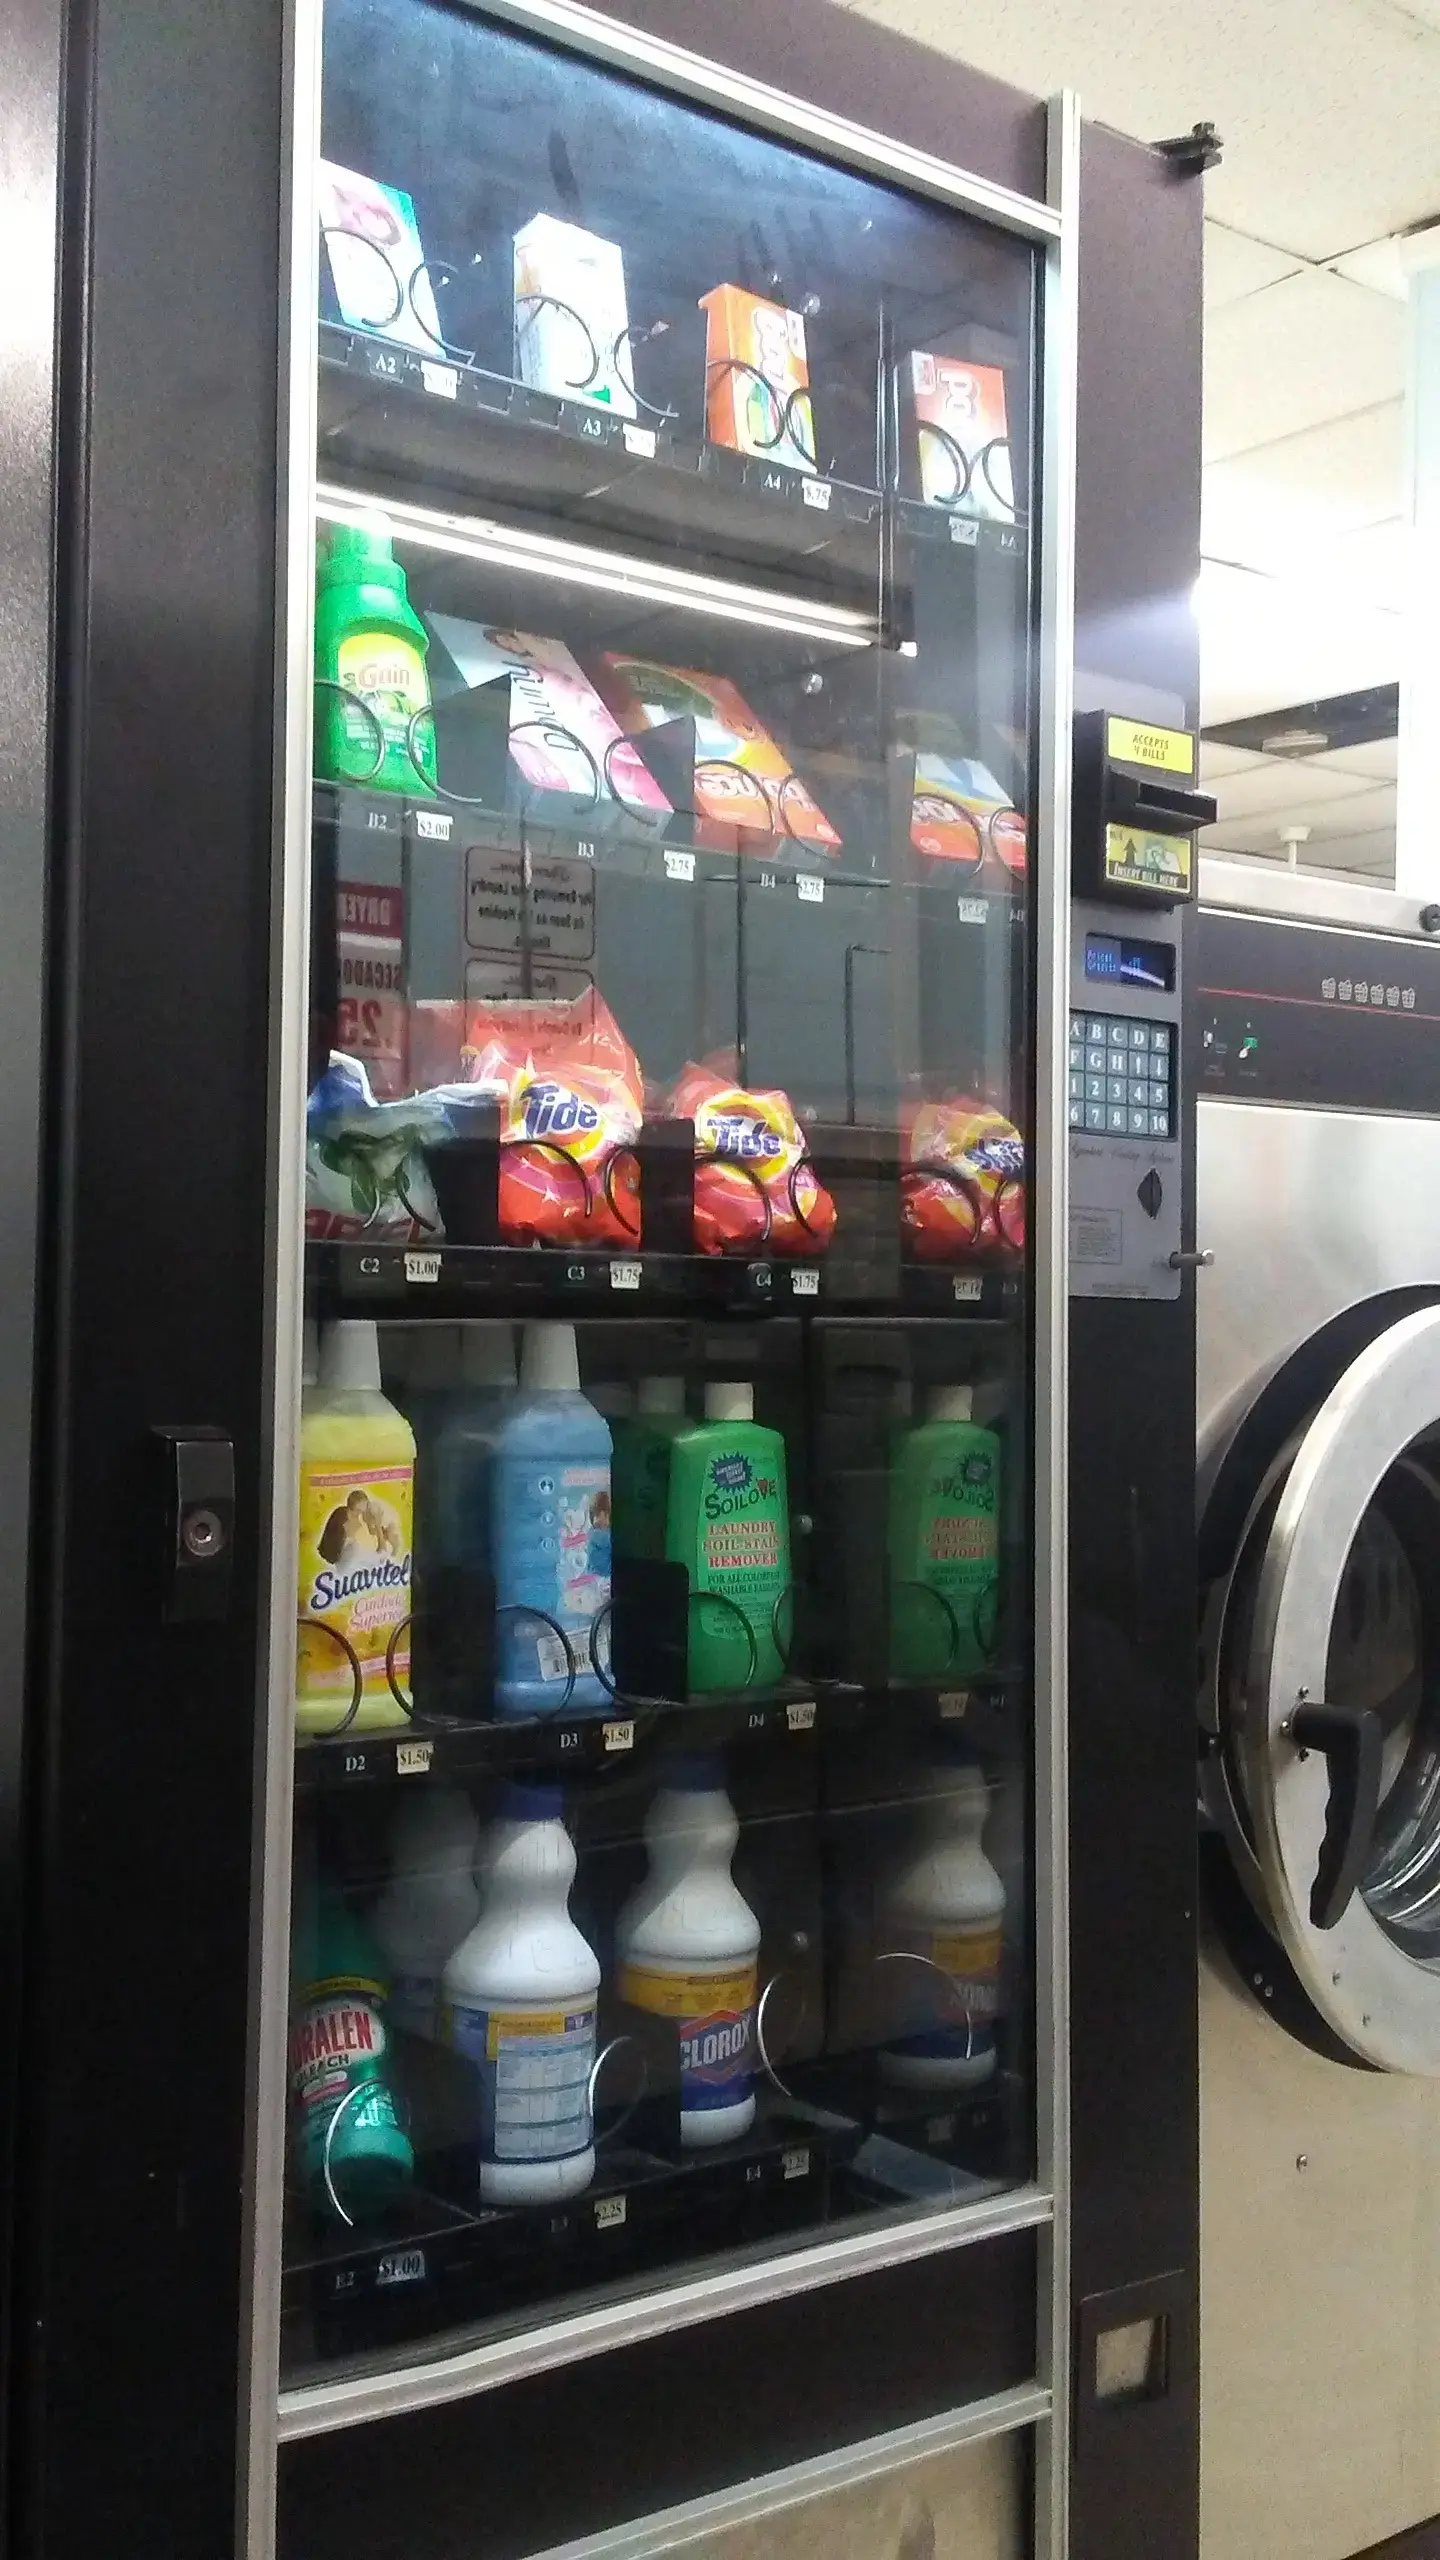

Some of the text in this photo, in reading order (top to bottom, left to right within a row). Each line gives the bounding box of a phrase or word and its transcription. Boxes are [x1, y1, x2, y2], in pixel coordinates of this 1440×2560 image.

[375, 354, 396, 373] A2
[583, 418, 602, 436] A3
[764, 473, 781, 490] A4
[359, 664, 409, 688] Gain
[1132, 734, 1169, 750] ACCEPTS
[1142, 747, 1165, 761] BILLS
[419, 819, 448, 838] $2.00
[577, 841, 595, 858] B3
[664, 856, 693, 874] $2.75
[1070, 1021, 1165, 1048] A B C D E
[1070, 1049, 1123, 1070] F G H
[1071, 1078, 1163, 1103] 1 2 3 4 5
[521, 1083, 600, 1133] Tide
[1070, 1106, 1167, 1131] 6 7 8 9 10
[706, 1117, 781, 1156] Tide
[359, 1257, 380, 1274] C2
[408, 1259, 437, 1277] $1.00
[567, 1266, 586, 1281] C3
[613, 1267, 639, 1283] $1.75
[756, 1272, 772, 1287] C4
[709, 1521, 776, 1536] LAUNDRY
[708, 1551, 778, 1568] REMOVER
[310, 1553, 411, 1610] Suavitel
[708, 1573, 726, 1585] FOR
[560, 1732, 579, 1749] D3
[604, 1727, 630, 1746] $1.50
[345, 1755, 366, 1773] D2
[399, 1748, 430, 1767] $1.50
[293, 2011, 373, 2067] RALEN
[680, 2012, 752, 2072] CLOROX
